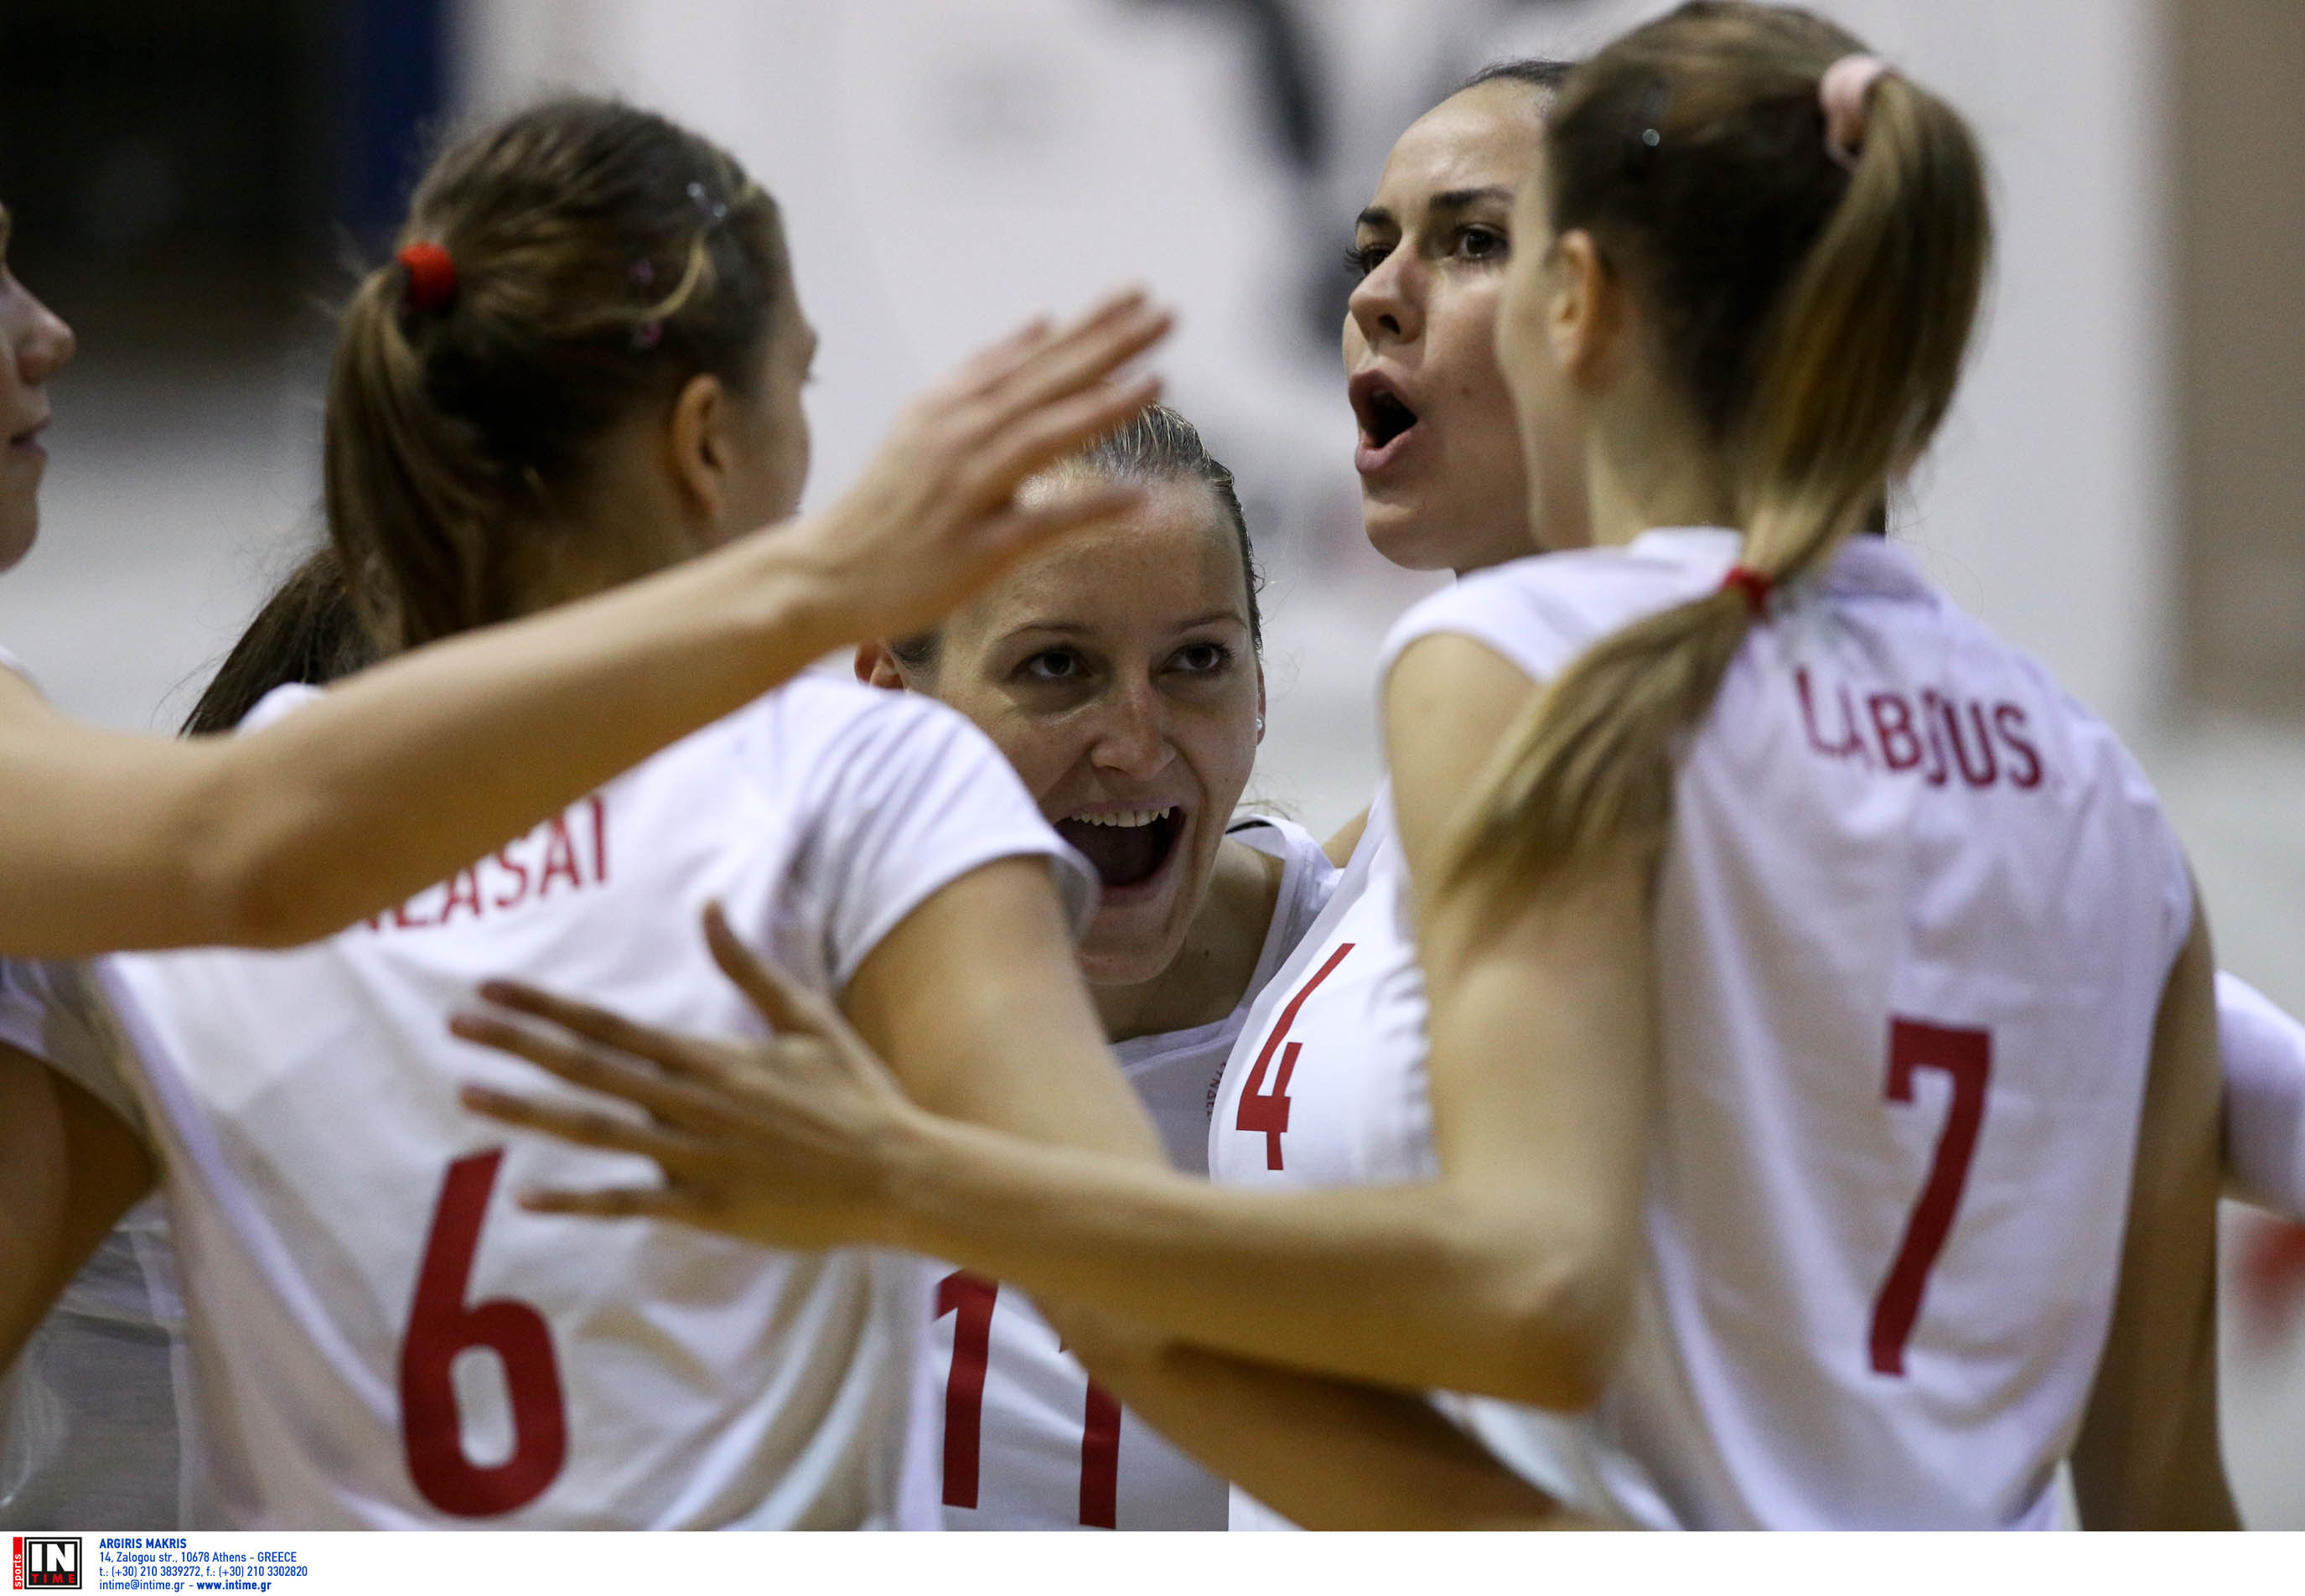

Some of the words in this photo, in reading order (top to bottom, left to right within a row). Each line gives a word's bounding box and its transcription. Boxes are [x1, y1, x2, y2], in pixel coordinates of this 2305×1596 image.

[1235, 943, 1356, 1171] 4
[1869, 1017, 1992, 1377] 7
[401, 1146, 569, 1519] 6
[934, 1269, 1121, 1529] 11
